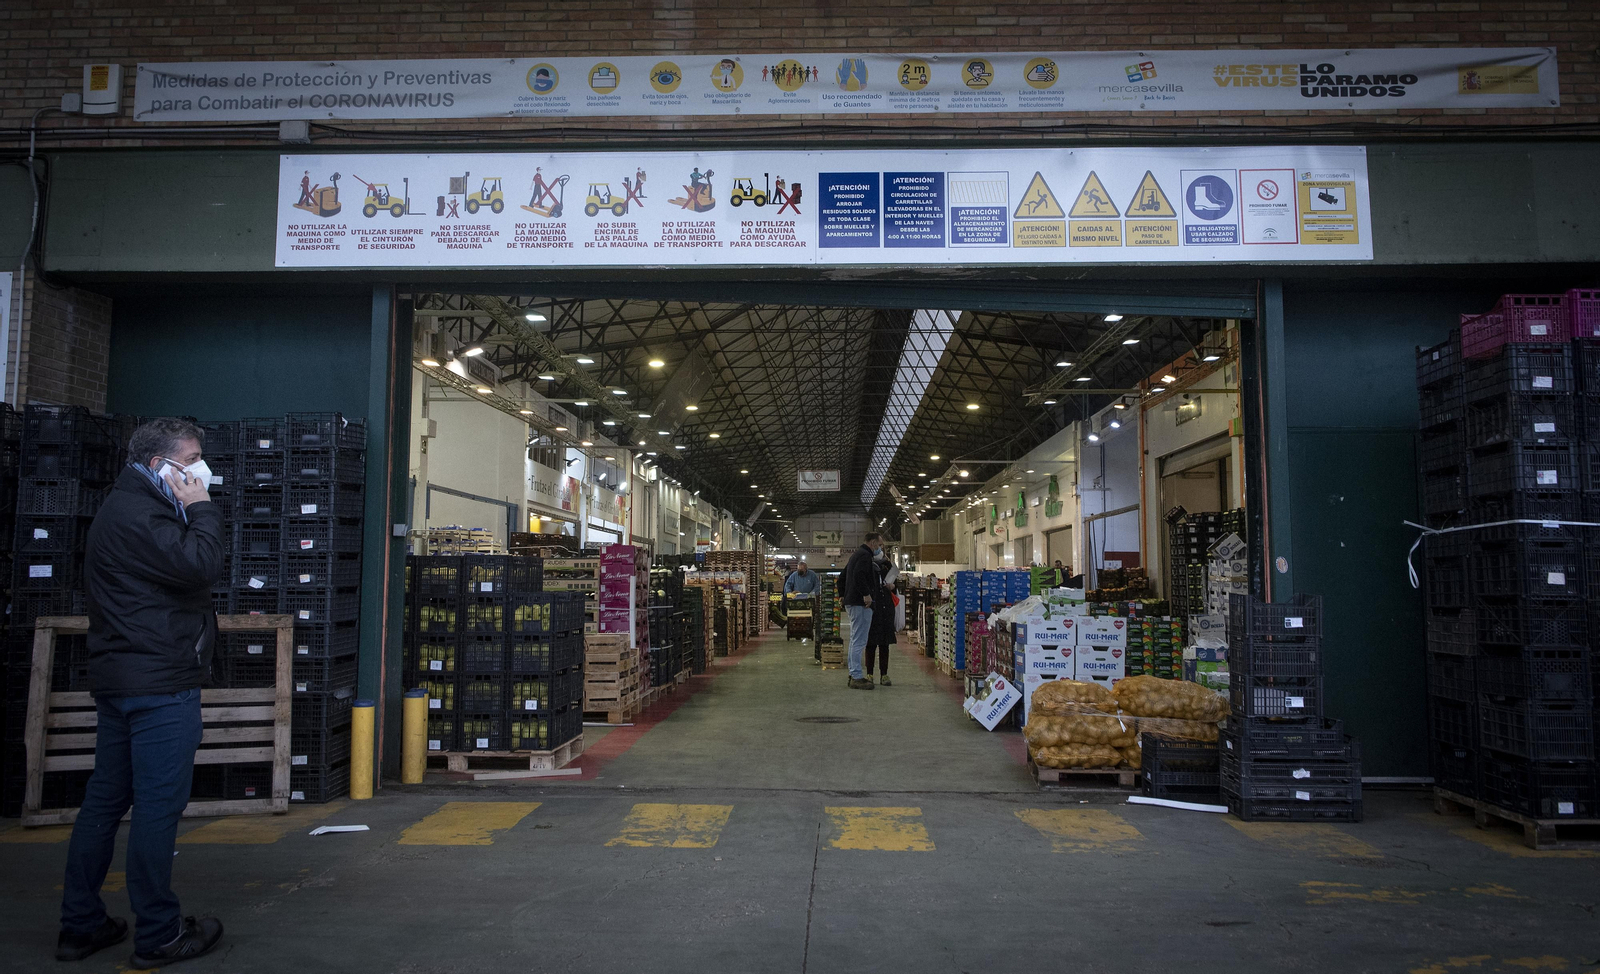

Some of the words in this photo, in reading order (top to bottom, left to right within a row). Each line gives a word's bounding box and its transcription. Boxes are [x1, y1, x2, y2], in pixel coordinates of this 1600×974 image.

[903, 64, 910, 74] 2
[914, 66, 925, 74] m
[1213, 64, 1298, 76] #ESTE
[1299, 63, 1336, 75] LO
[152, 73, 228, 89] Medidas
[233, 73, 257, 88] de
[262, 71, 363, 88] Protección
[367, 75, 378, 90] y
[383, 70, 492, 87] Preventivas
[1213, 76, 1298, 87] VIRUS
[1299, 74, 1419, 86] PARAMO
[1098, 83, 1184, 93] mercasevilla
[1300, 85, 1407, 98] UNIDOS
[151, 98, 192, 115] para
[197, 94, 282, 111] Combatir
[287, 94, 304, 110] el
[310, 93, 455, 109] CORONAVIRUS
[893, 176, 935, 185] ¡ATENCIÓN!
[828, 184, 870, 192] ¡ATENCIÓN!
[958, 208, 1000, 216] ¡ATENCIÓN!
[1019, 225, 1060, 233] ¡ATENCIÓN!
[1132, 225, 1172, 233] ¡ATENCIÓN!
[1085, 633, 1119, 641] RUI-MAR
[1033, 661, 1067, 669] RUI-MAR
[1083, 662, 1117, 670] RUI-MAR
[986, 693, 1012, 721] RUI-MAR
